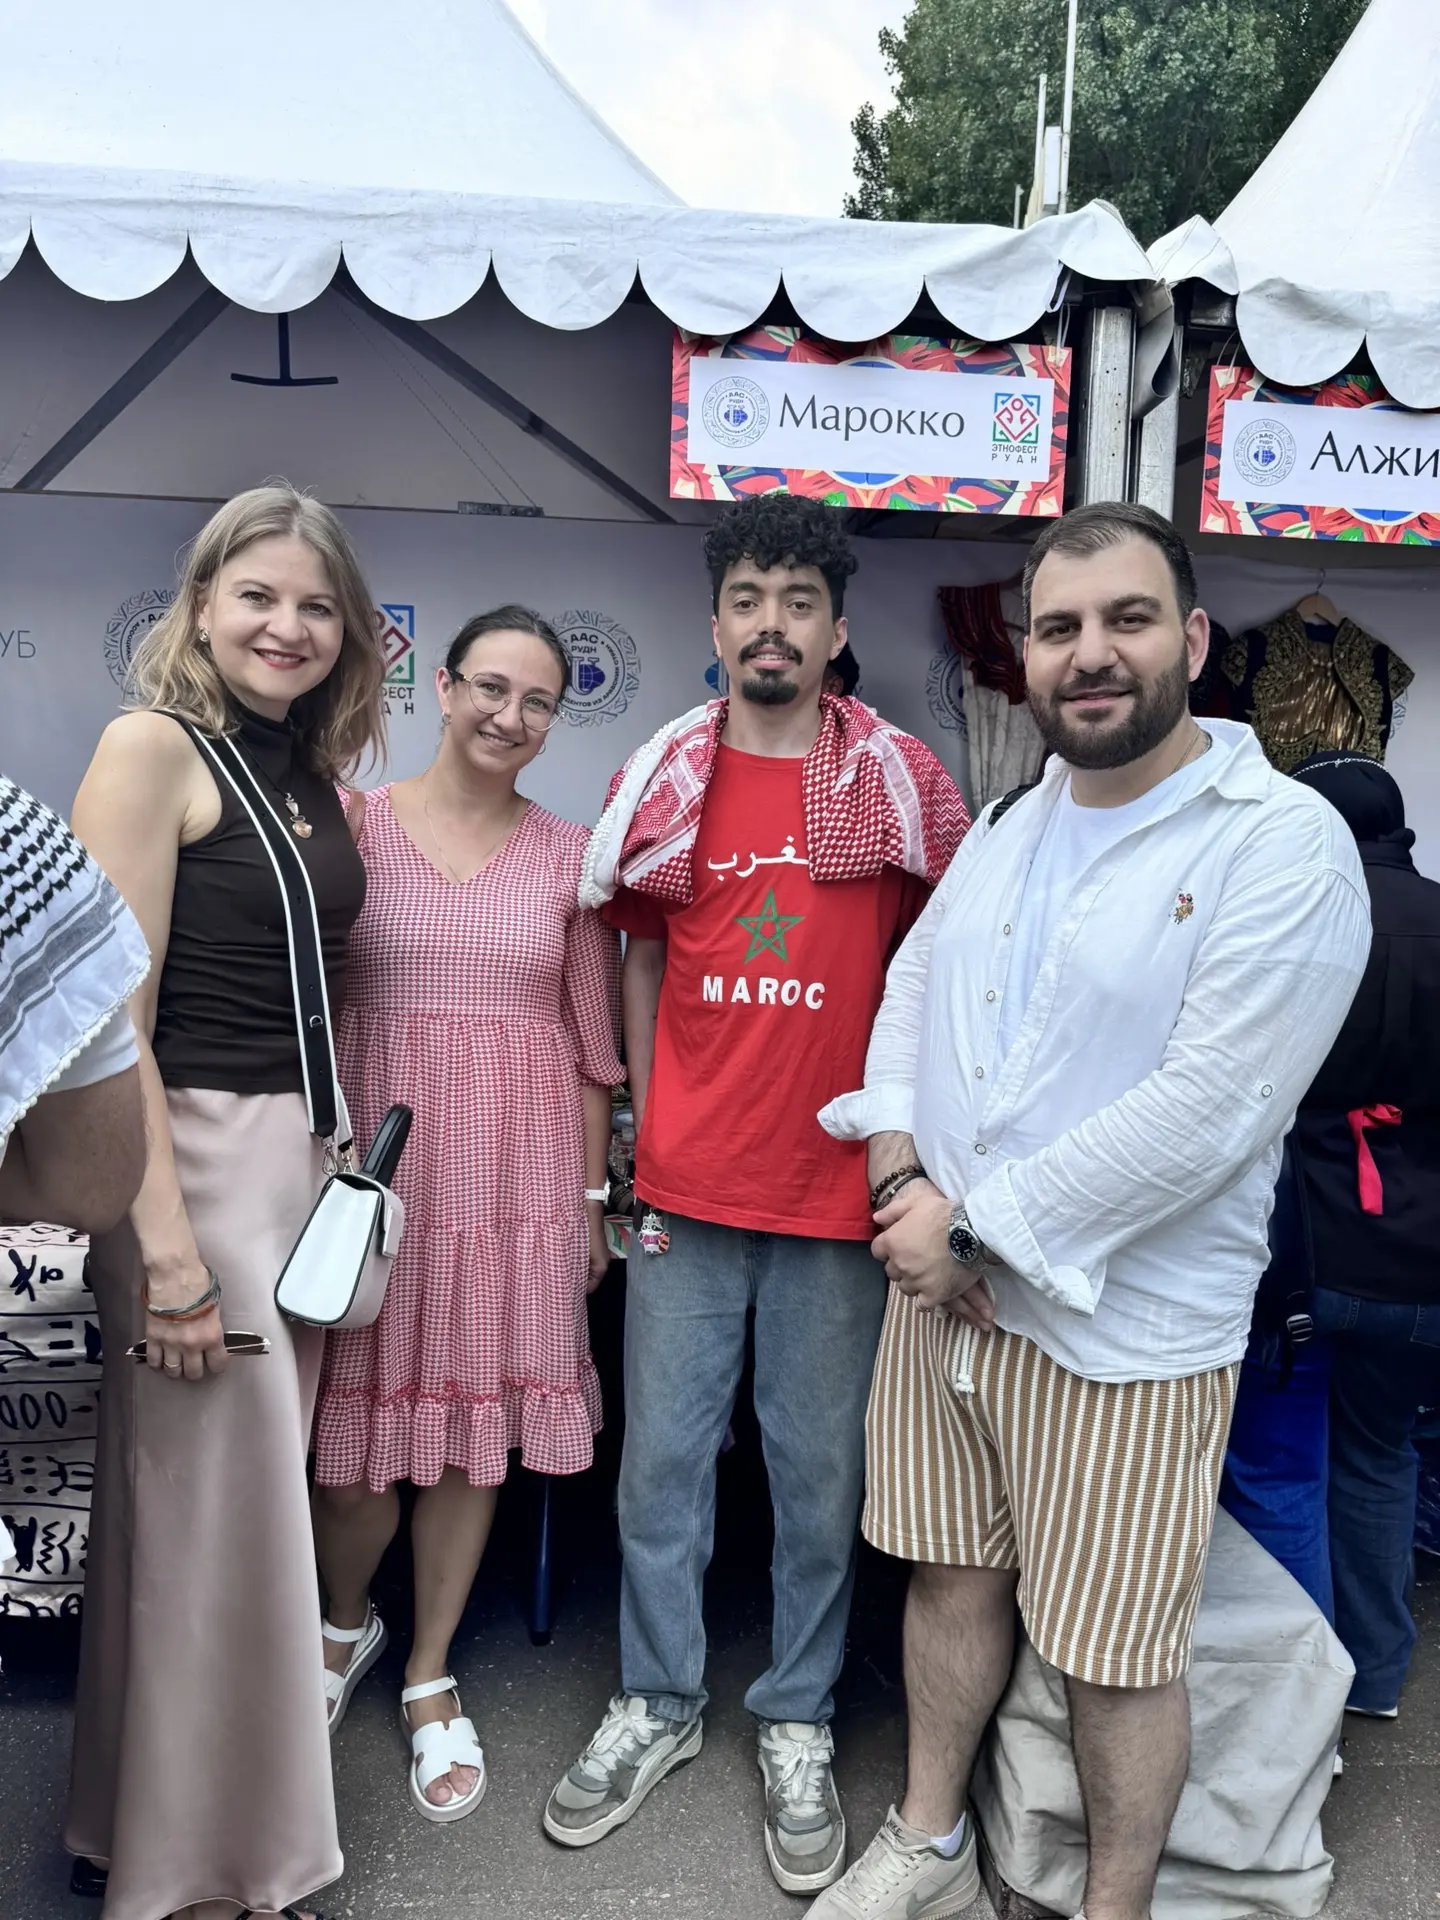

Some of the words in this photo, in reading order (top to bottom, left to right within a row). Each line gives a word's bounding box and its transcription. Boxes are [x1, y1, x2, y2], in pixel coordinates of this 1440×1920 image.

[779, 392, 965, 441] Марокко
[991, 453, 1037, 464] РУДН
[992, 443, 1038, 454] ЭТНОФЕСТ
[1309, 430, 1440, 478] Алжи
[570, 633, 599, 644] ААС
[571, 646, 597, 654] РУДН
[707, 835, 809, 882] غرب
[702, 975, 826, 1010] MAROC
